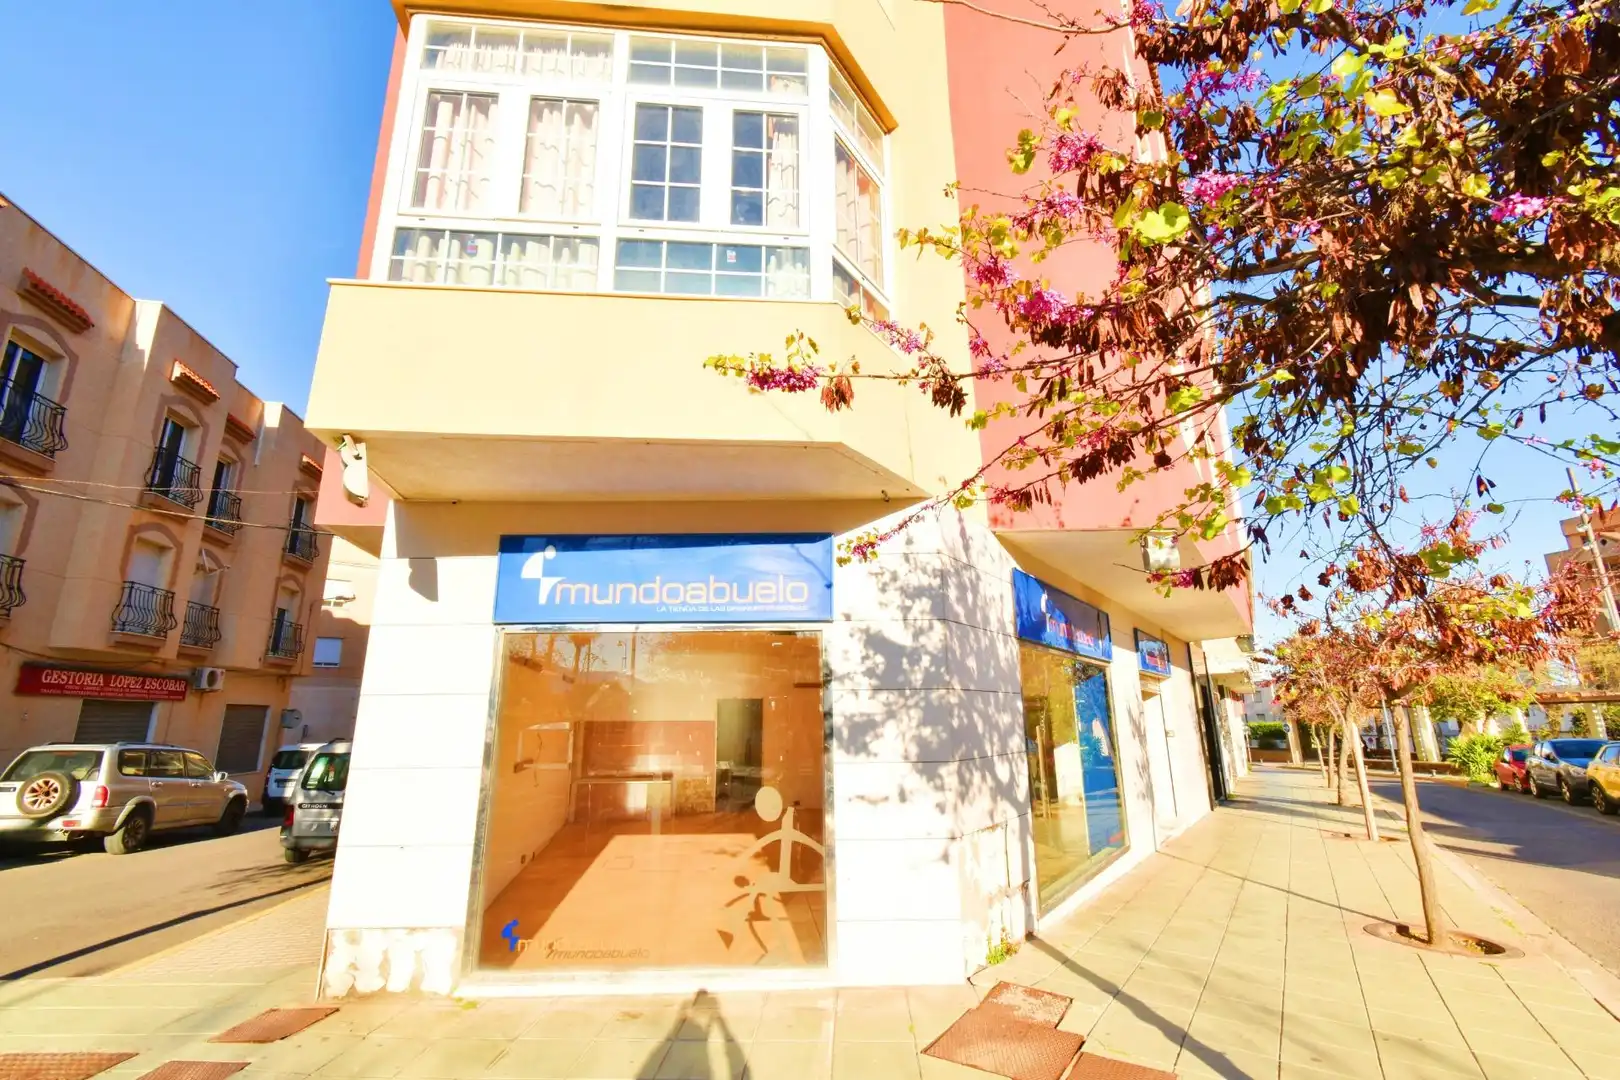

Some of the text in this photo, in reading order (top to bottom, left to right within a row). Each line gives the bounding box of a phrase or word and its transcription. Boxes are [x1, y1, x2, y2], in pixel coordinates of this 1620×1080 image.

[554, 574, 809, 605] mundoabuelo
[668, 605, 696, 613] TIENDA
[41, 669, 104, 686] GESTORIA
[109, 674, 143, 688] LOPEZ
[144, 679, 187, 692] ESCOBAR
